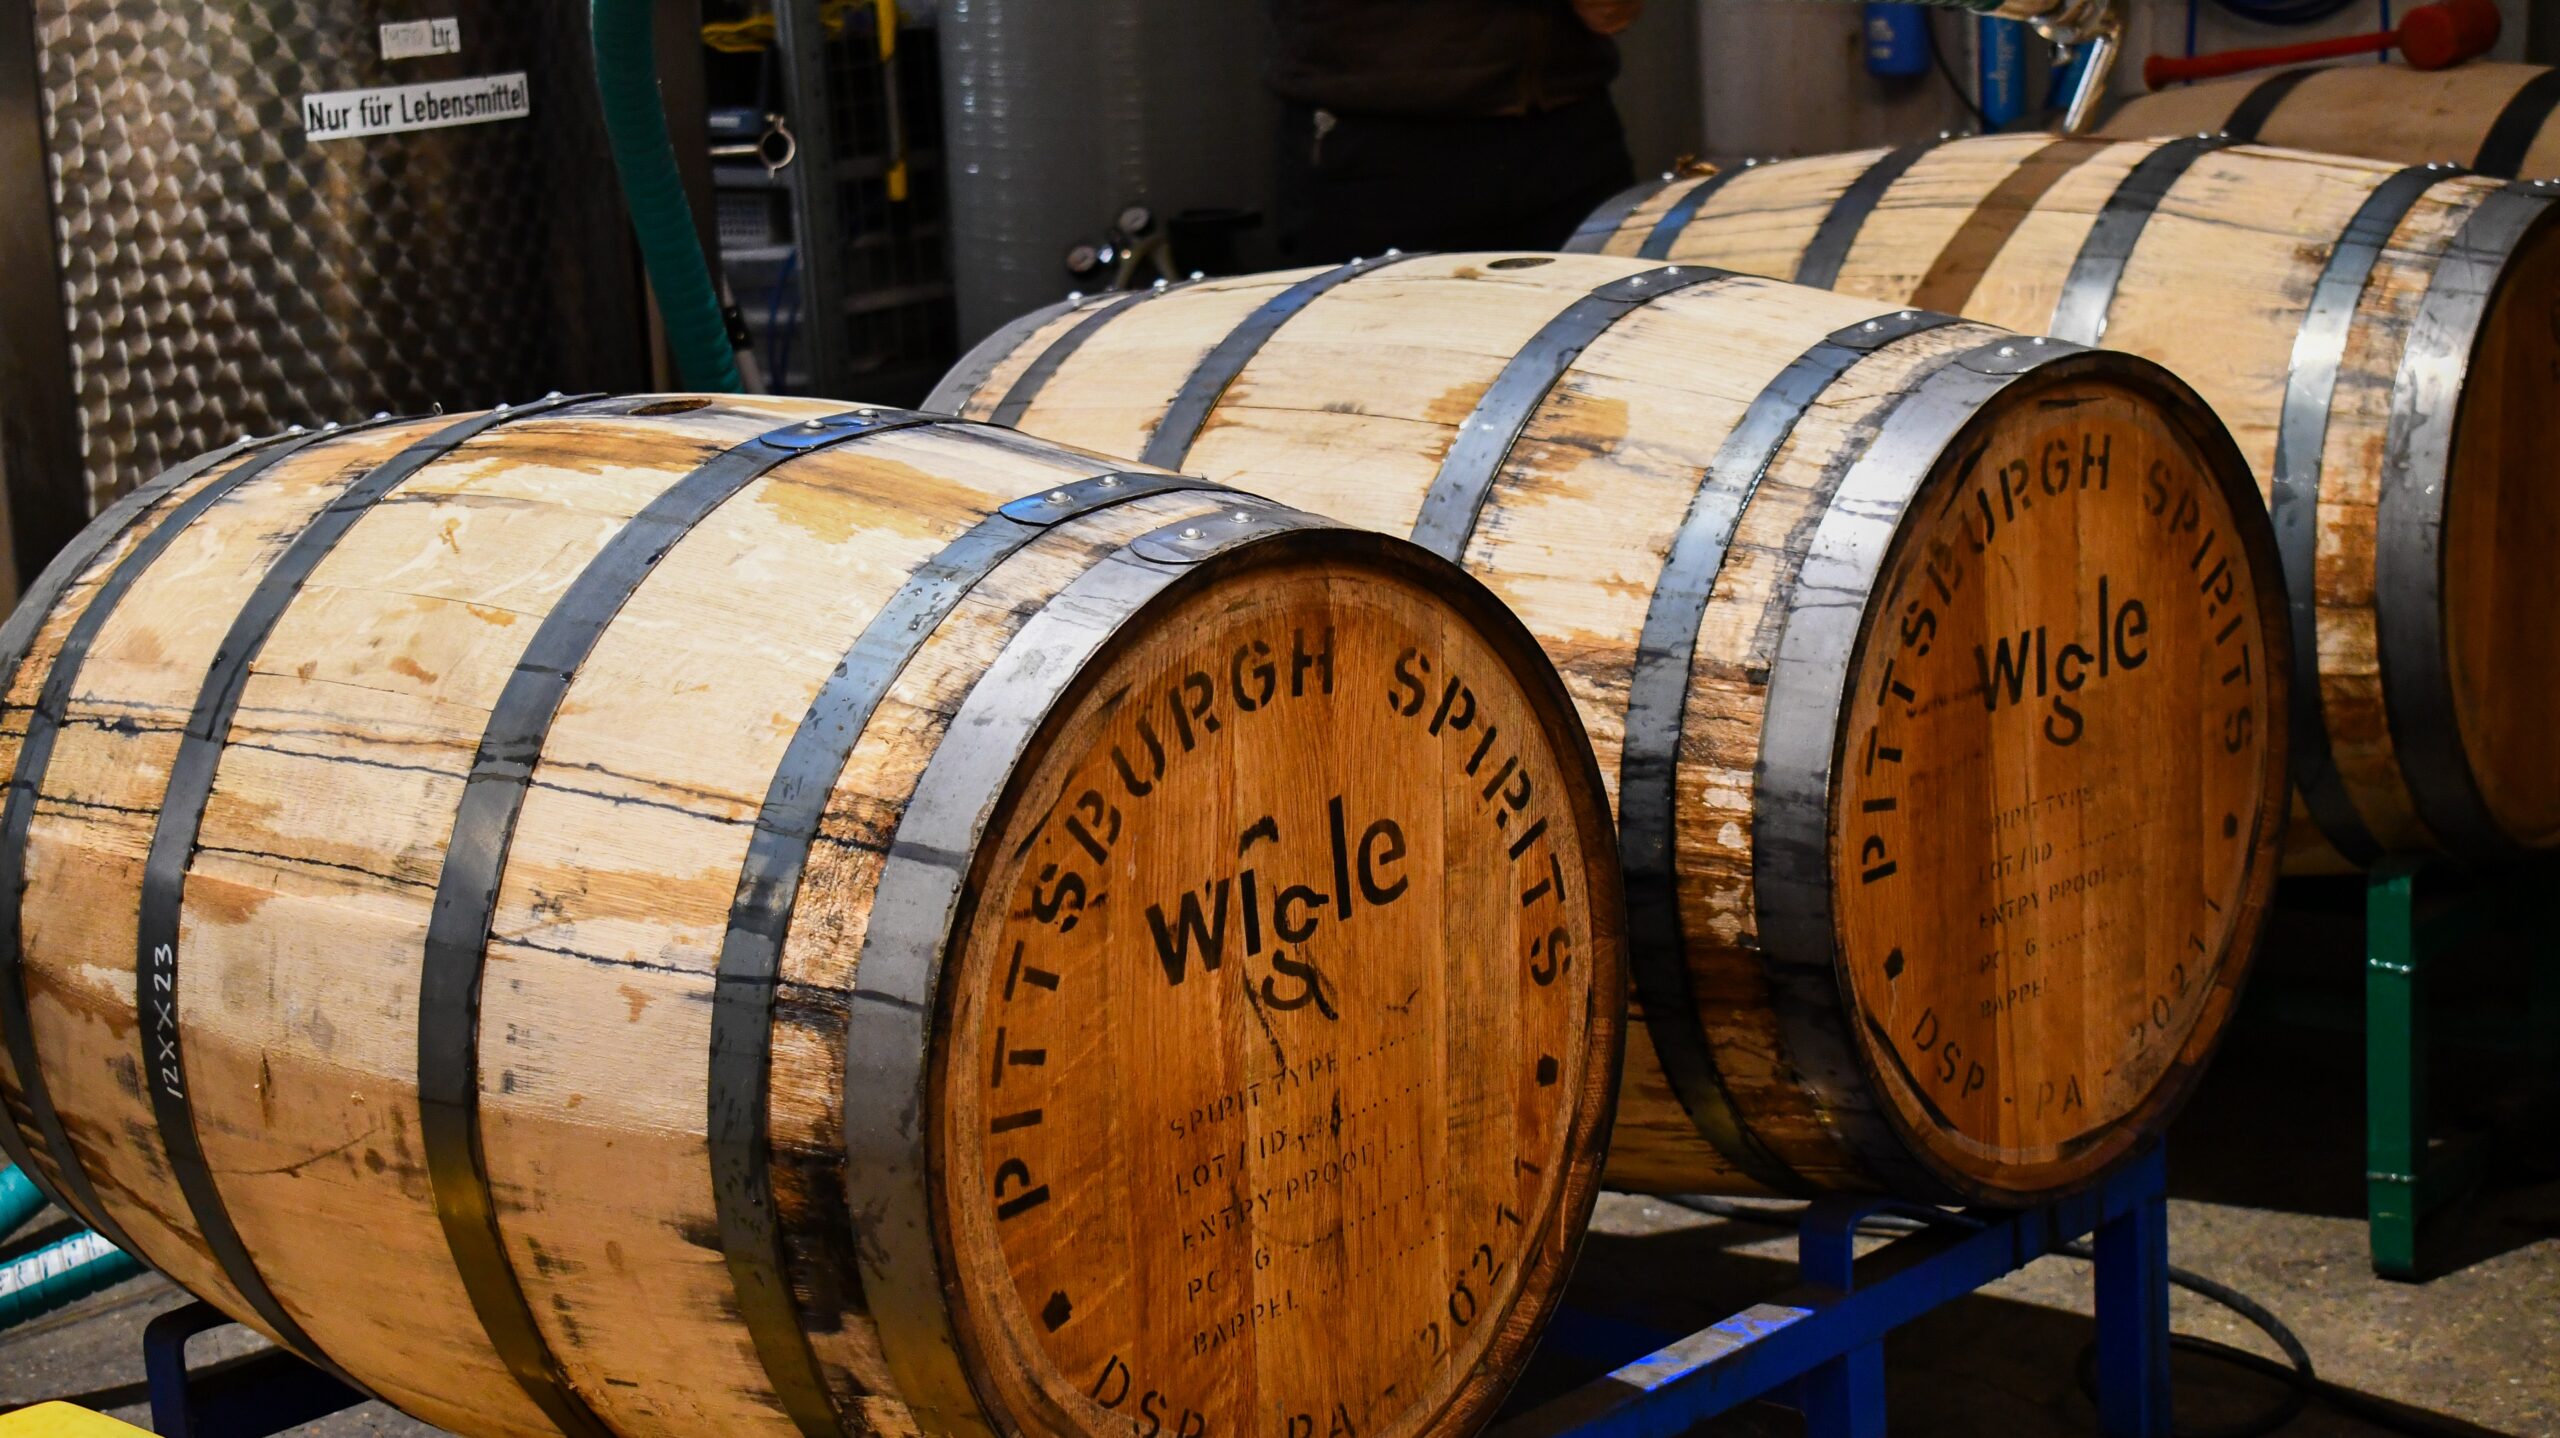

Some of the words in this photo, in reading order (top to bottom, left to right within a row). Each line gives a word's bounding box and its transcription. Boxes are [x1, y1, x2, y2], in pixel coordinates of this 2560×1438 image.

[307, 103, 351, 133] Nur
[358, 95, 393, 129] für
[400, 81, 526, 124] Lebensmittel
[1862, 432, 2112, 885] PITTSBURGH
[2144, 458, 2253, 755] SPIRITS
[990, 625, 1336, 1222] PITTSBURGH
[1387, 646, 1572, 987] SPIRITS
[1170, 1082, 1261, 1140] SPIRIT
[1272, 1053, 1339, 1096] TYPE
[1174, 1153, 1226, 1196] LOT
[1259, 1129, 1288, 1160] ID
